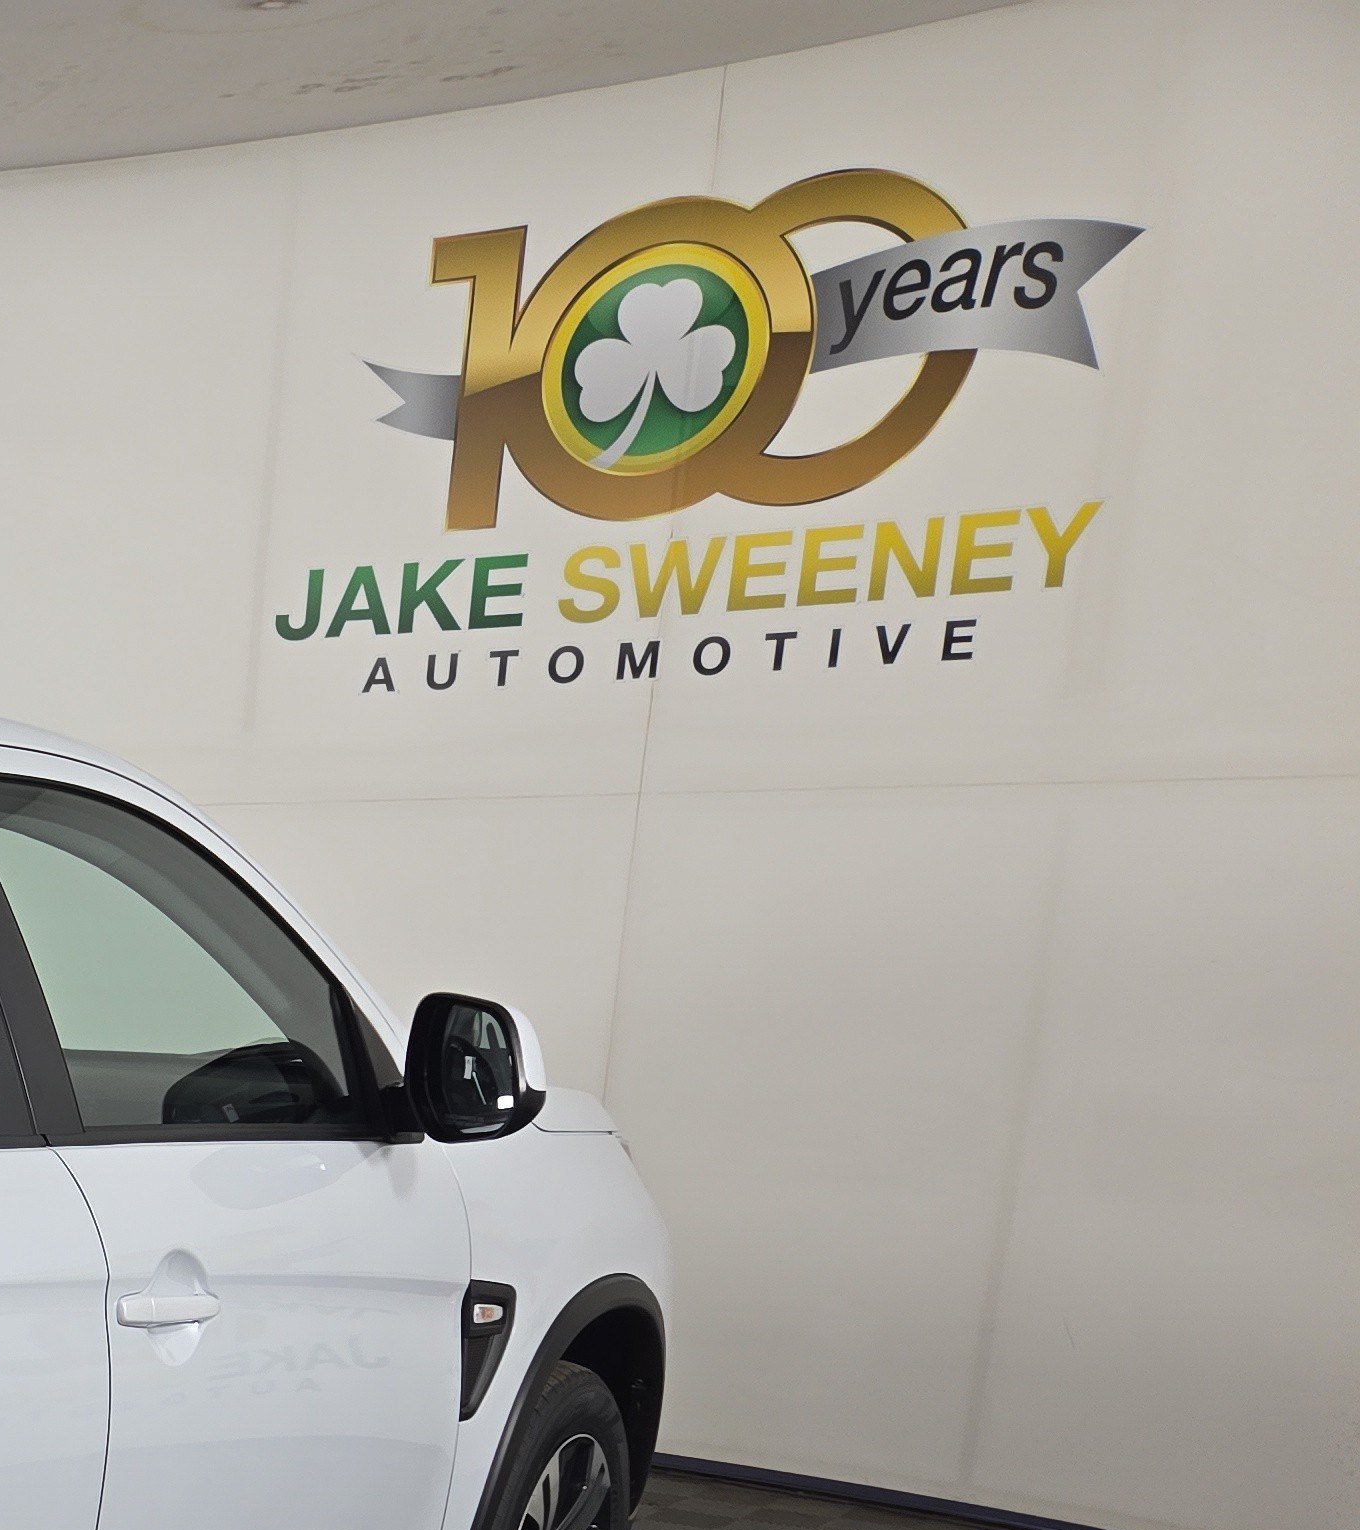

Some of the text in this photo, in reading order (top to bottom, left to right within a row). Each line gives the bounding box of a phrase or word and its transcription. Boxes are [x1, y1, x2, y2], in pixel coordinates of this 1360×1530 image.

[432, 167, 978, 532] 100
[829, 238, 1064, 356] years
[276, 500, 1104, 642] JAKE SWEENEY
[361, 619, 978, 694] AUTOMOTIVE
